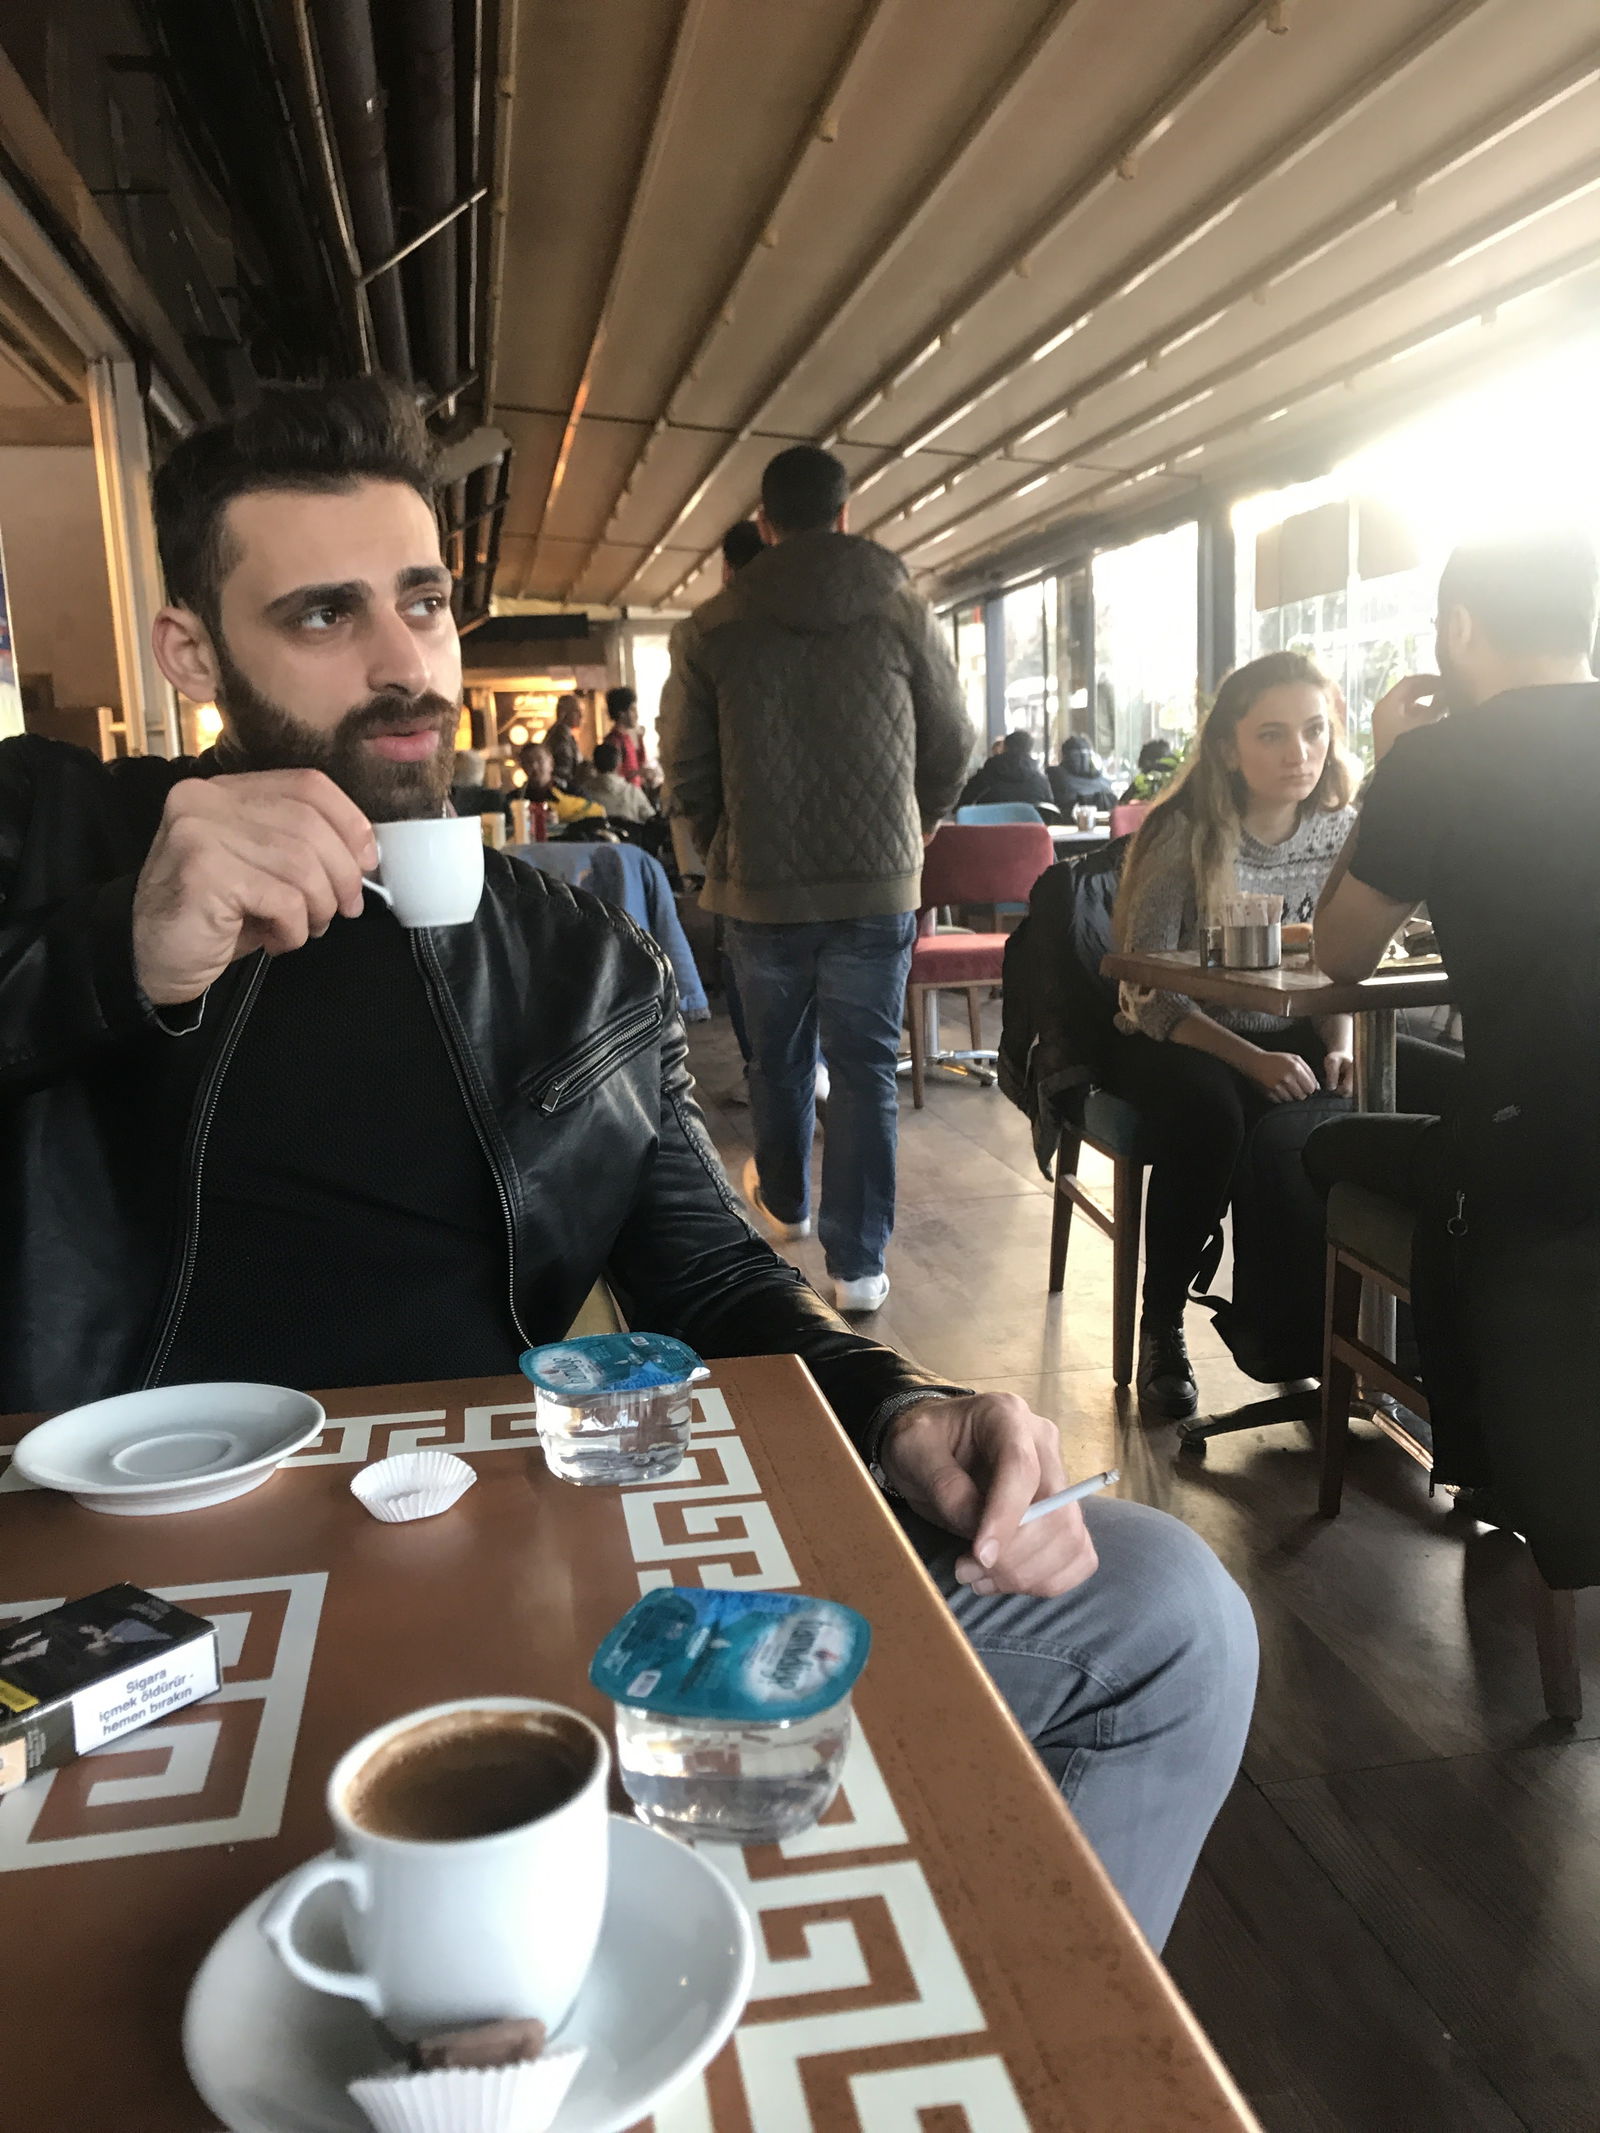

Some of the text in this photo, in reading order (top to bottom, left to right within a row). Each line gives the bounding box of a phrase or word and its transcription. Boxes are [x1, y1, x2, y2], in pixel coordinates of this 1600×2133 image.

[99, 1697, 138, 1722] içmek
[141, 1674, 187, 1703] öldürür
[126, 1668, 167, 1694] Sigara
[103, 1687, 193, 1735] hemen bırakın
